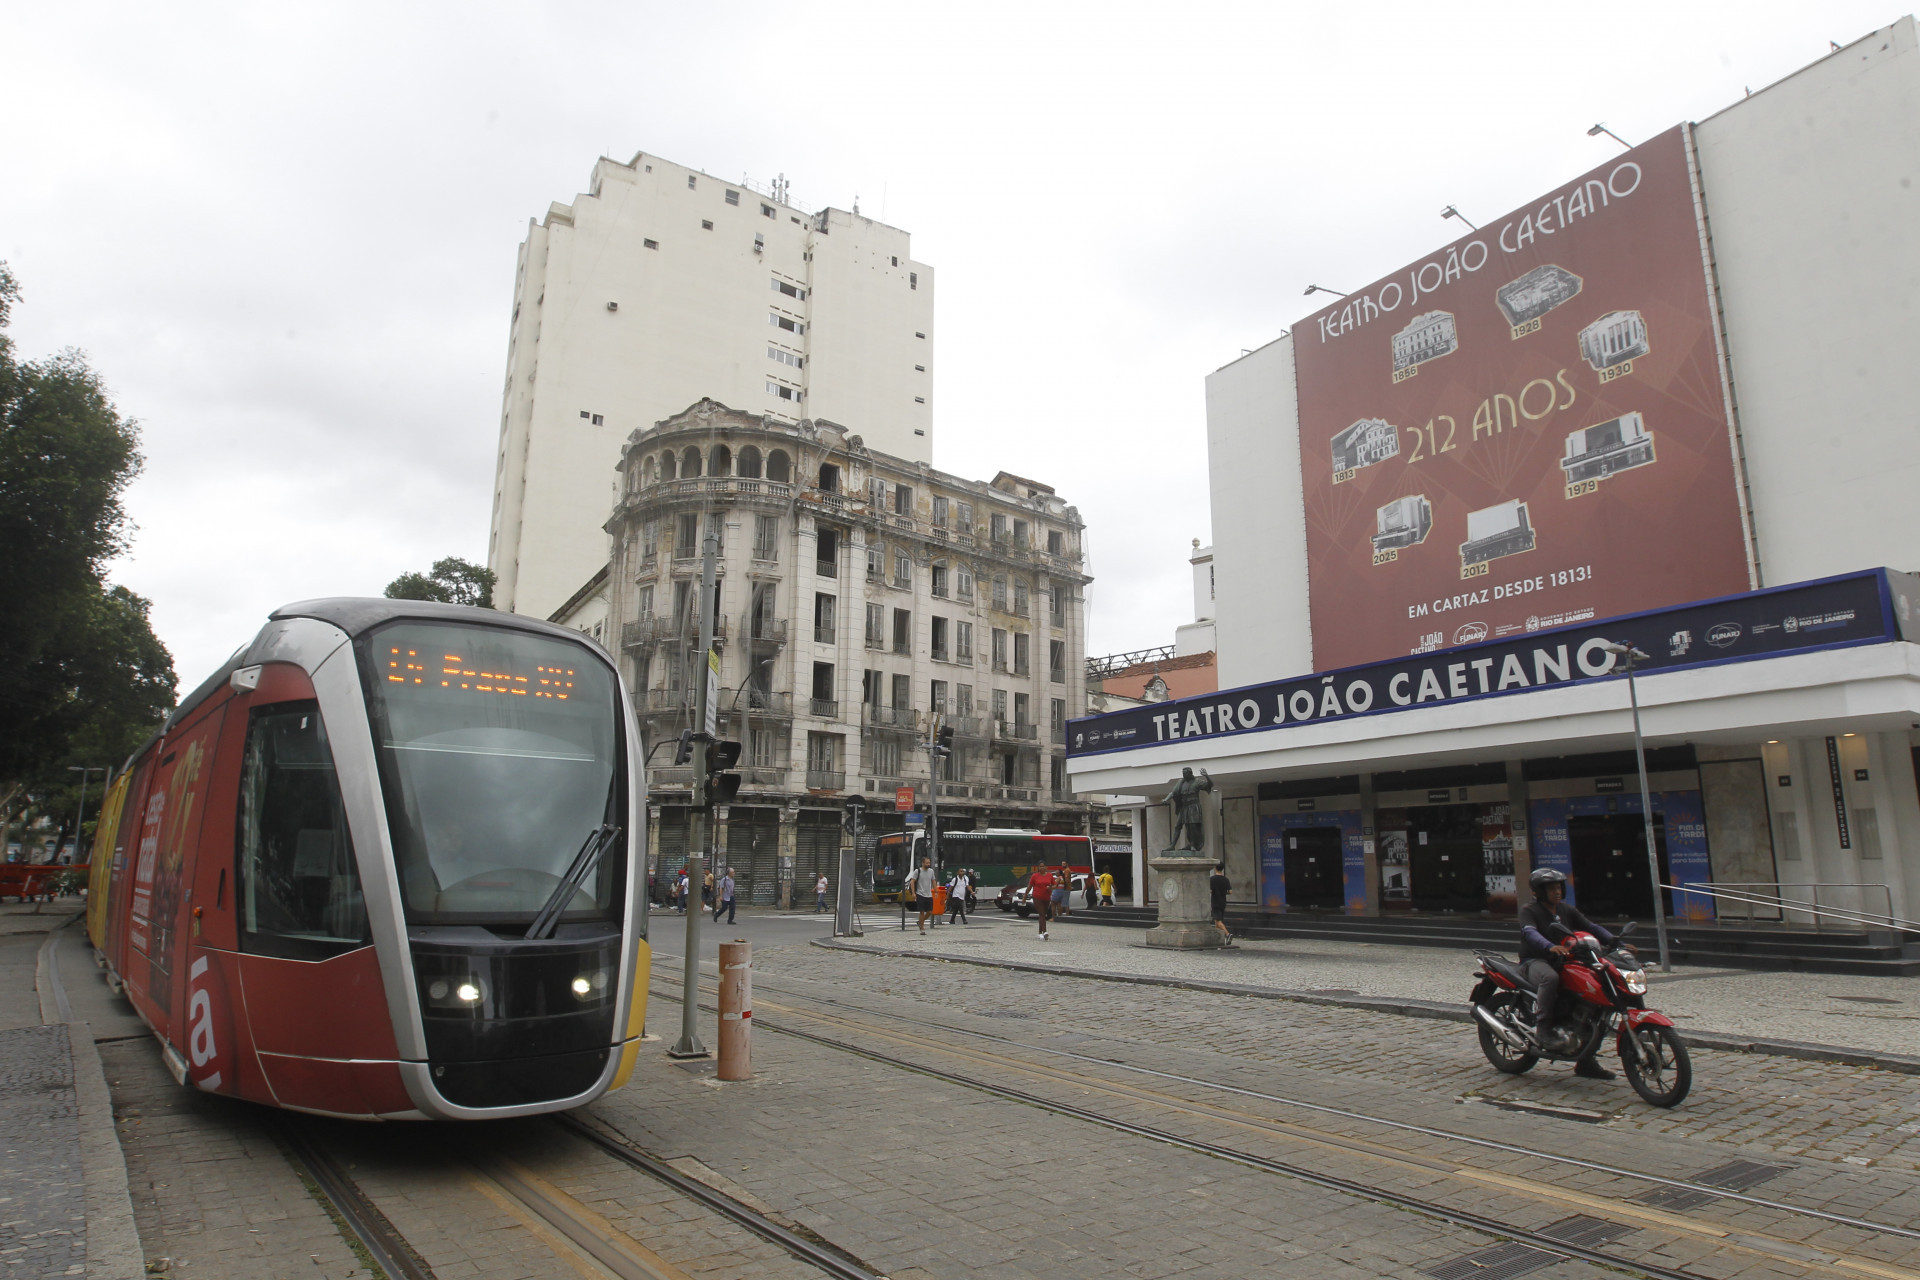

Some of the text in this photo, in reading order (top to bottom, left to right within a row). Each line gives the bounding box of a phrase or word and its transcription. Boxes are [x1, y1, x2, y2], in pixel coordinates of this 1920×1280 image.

[1318, 162, 1641, 343] TEATRO JOÃO CAETANO
[1514, 320, 1539, 338] 1928
[1393, 366, 1417, 381] 1856
[1601, 362, 1631, 381] 1930
[1406, 369, 1576, 464] 212 ANOS
[1334, 470, 1354, 482] 1813
[1568, 480, 1596, 496] 1979
[1373, 550, 1397, 565] 2025
[1463, 564, 1487, 577] 2012
[1408, 565, 1592, 618] EM CARTAZ DESDE 1813!
[1540, 611, 1595, 627] RIO DE JANEIRO
[1824, 613, 1856, 623] JANEIRO
[1424, 631, 1443, 646] JOÃO
[1152, 637, 1617, 741] TEATRO JOÃO CAETANO
[1482, 815, 1504, 825] CAETANO
